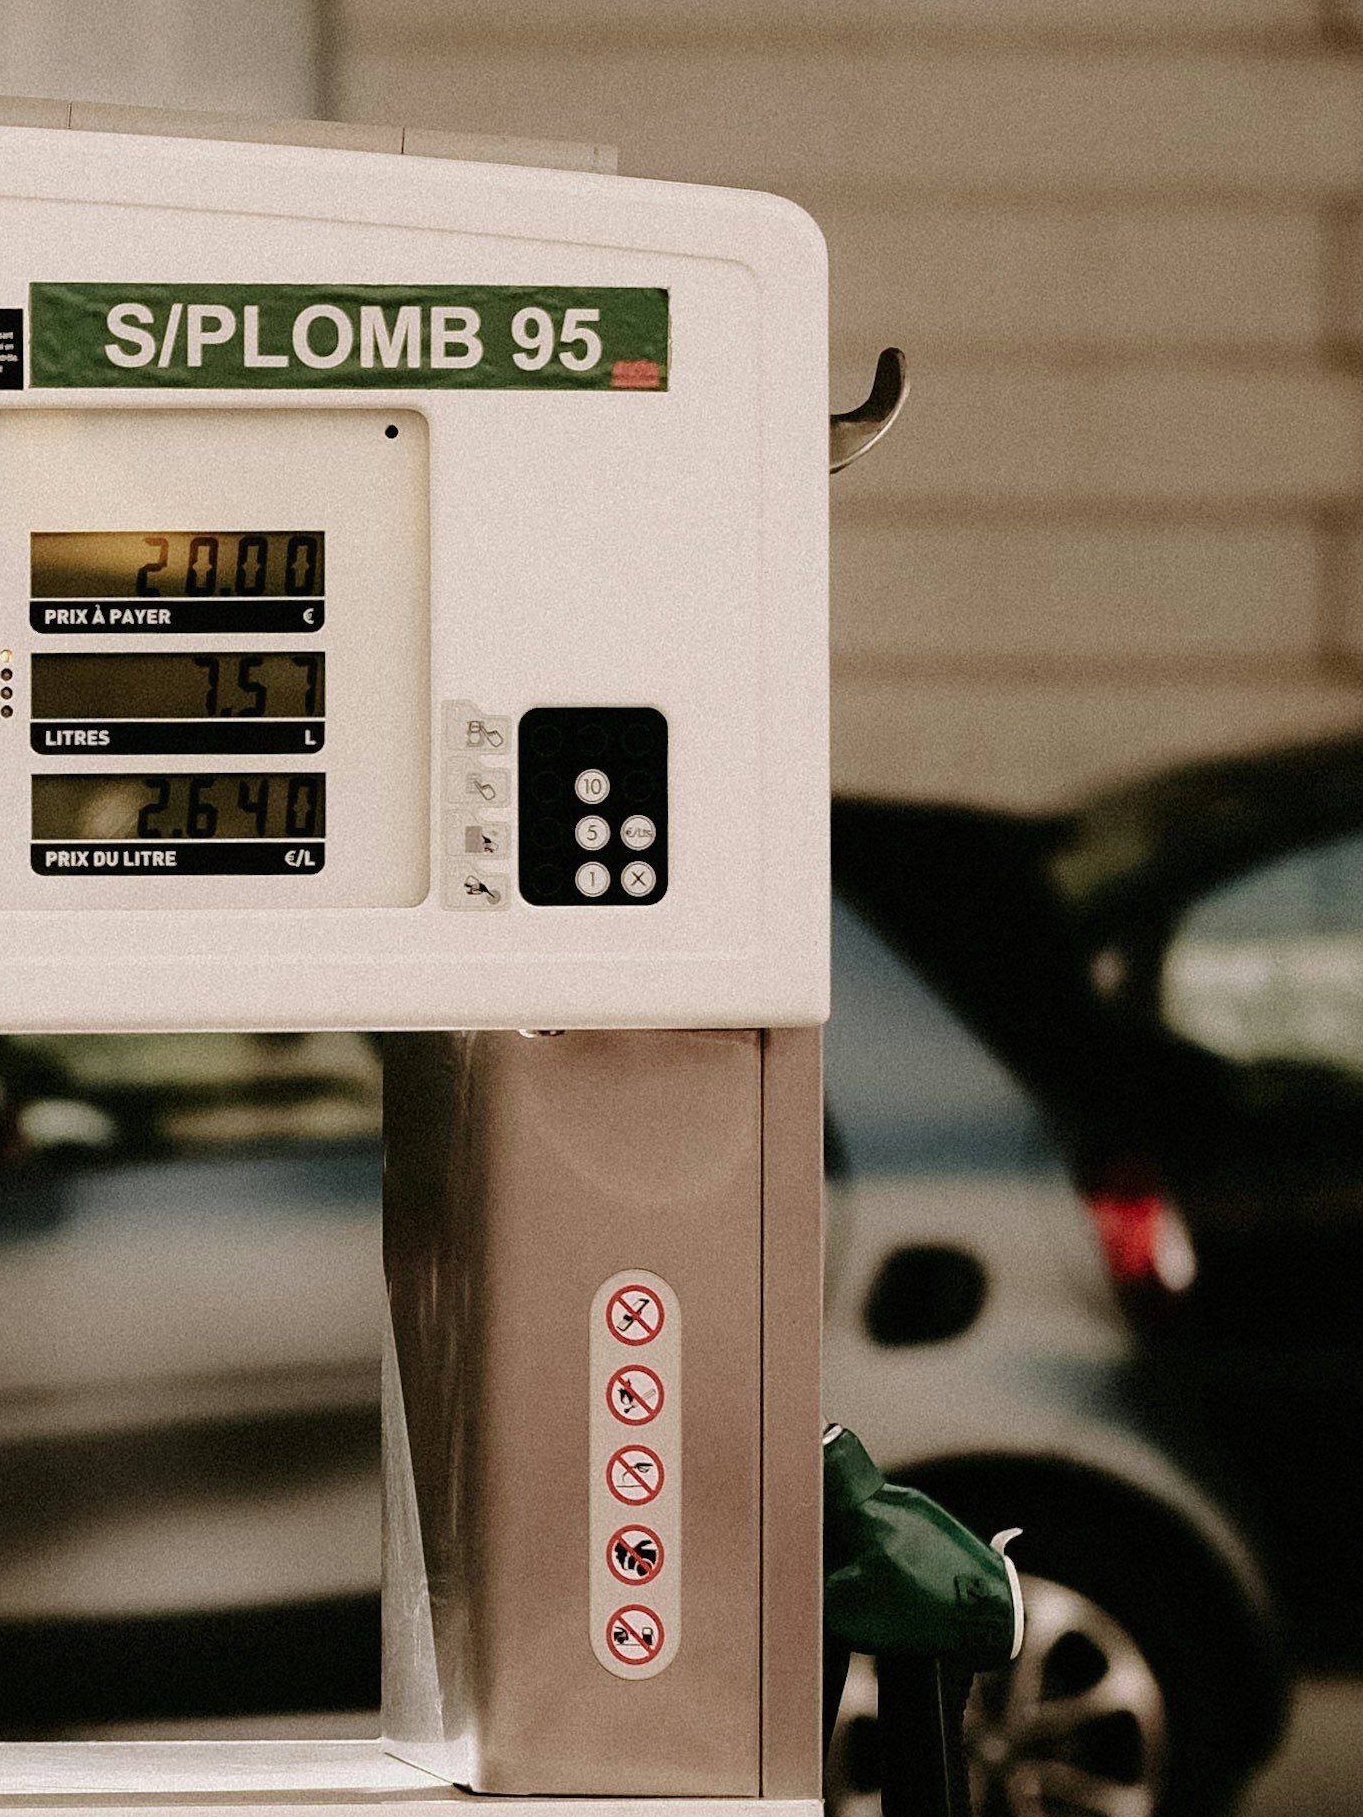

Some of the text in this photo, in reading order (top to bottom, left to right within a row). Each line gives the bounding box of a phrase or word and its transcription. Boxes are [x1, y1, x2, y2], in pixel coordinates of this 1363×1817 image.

[105, 303, 603, 371] S/PLOMB 95
[136, 536, 317, 597] 20.00
[44, 604, 171, 625] PRIX À PAYER
[303, 607, 315, 624] €
[193, 656, 318, 718] 7.57
[45, 730, 110, 746] LITRES
[304, 729, 317, 746] L
[583, 778, 602, 795] 10
[137, 777, 318, 839] 2.640
[587, 825, 598, 841] 5
[45, 850, 177, 867] PRIX DU LITRE
[284, 849, 315, 868] €/L
